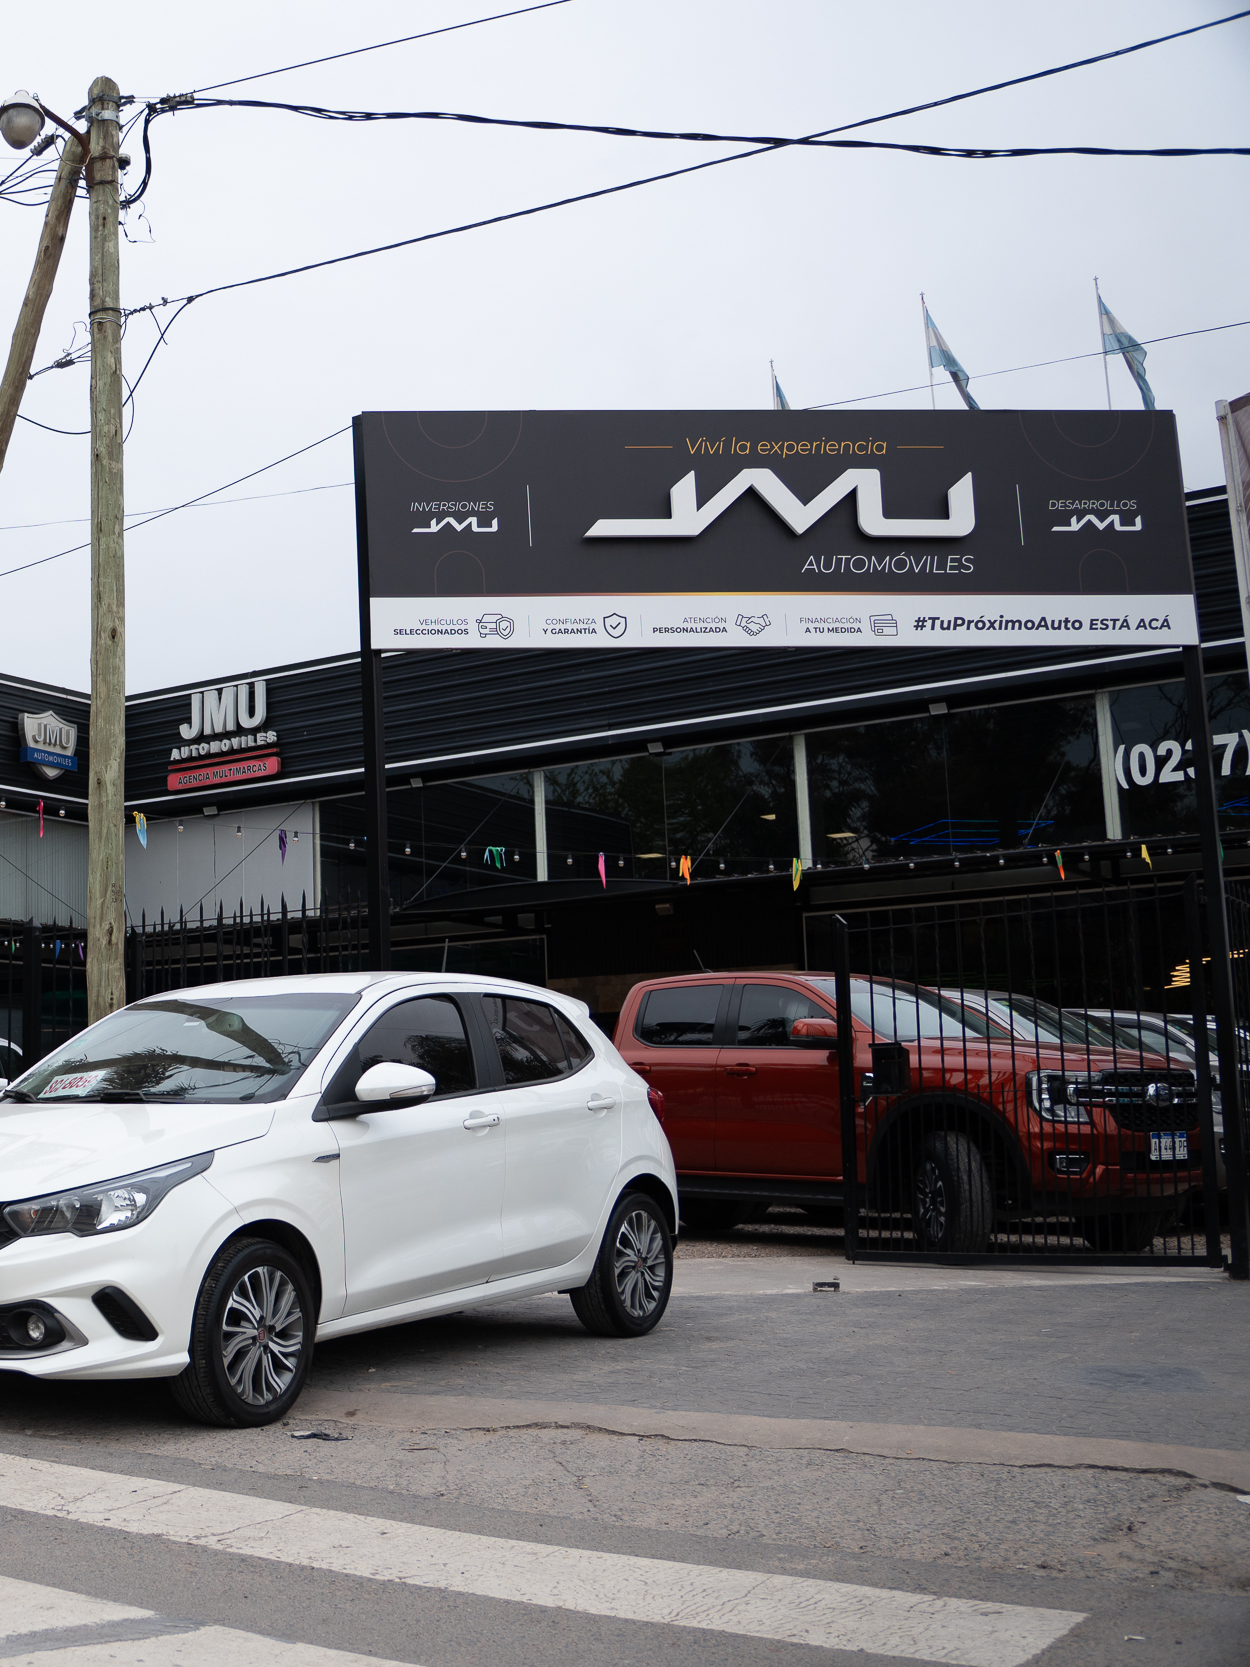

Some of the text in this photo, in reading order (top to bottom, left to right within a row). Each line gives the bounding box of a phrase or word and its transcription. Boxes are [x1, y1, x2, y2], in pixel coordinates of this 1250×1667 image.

[686, 437, 887, 458] Viví la experiencia
[410, 501, 494, 512] INVERSIONES
[583, 468, 976, 538] JMU
[1048, 500, 1137, 510] DESARROLLOS
[801, 551, 974, 574] AUTOMÓVILES
[418, 617, 469, 626] VEHÍCULOS
[545, 618, 597, 626] CONFIANZA
[682, 615, 727, 624] ATENCIÓN
[799, 615, 862, 624] FINANCIACIÓN
[913, 615, 1172, 631] #TuPróximoAuto ESTÁ ACÁ
[393, 628, 469, 636] SELECCIONADOS
[551, 626, 598, 635] GARANTÍA
[652, 626, 728, 634] PERSONALIZADA
[804, 626, 863, 634] A TU MEDIDA
[179, 681, 267, 740] JMU
[32, 722, 72, 749] JMU
[170, 731, 278, 761] AUTOMOVILES
[33, 752, 72, 767] AUTOMOVILES
[1114, 729, 1250, 789] (027)
[177, 762, 268, 786] AGENCIA MULTIMARCAS
